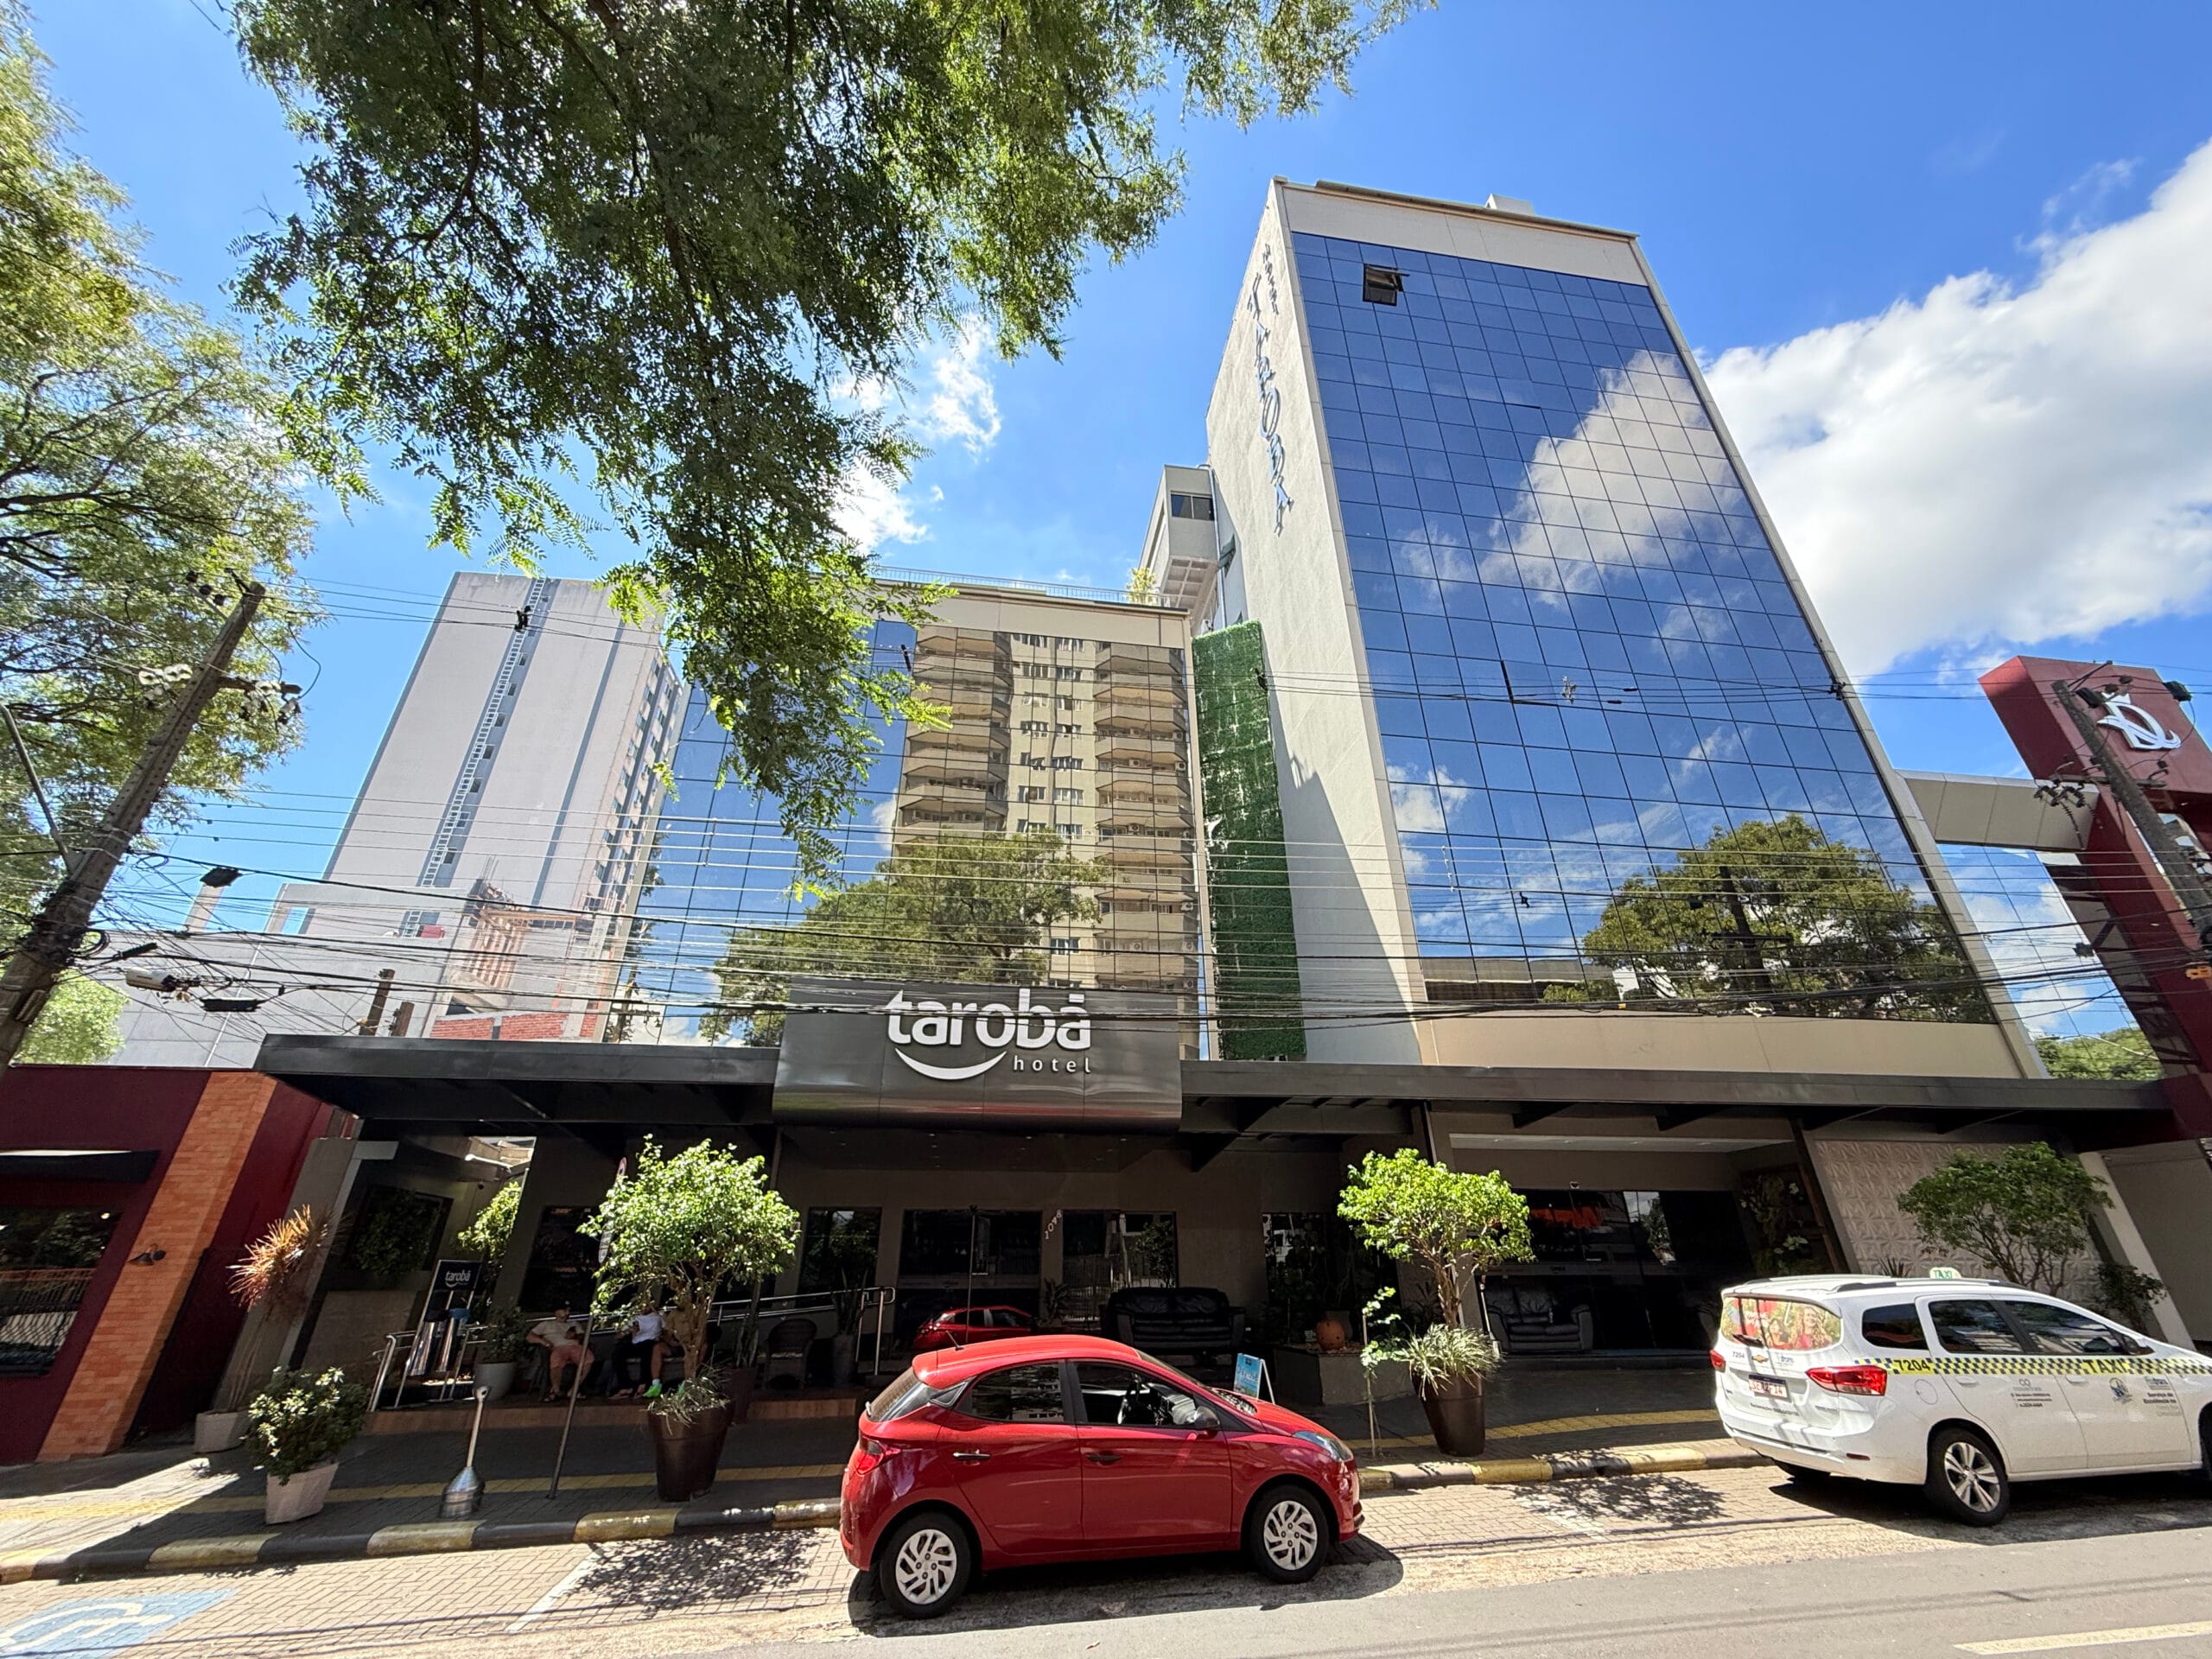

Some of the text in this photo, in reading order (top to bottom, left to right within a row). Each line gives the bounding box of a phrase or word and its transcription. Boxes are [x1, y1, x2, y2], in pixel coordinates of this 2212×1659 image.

[885, 988, 1091, 1050] tarobá
[1013, 1054, 1090, 1073] hotel
[1045, 1209, 1062, 1240] 1048
[445, 1269, 471, 1281] tarobá
[1933, 1269, 1953, 1280] TAXI
[1732, 1351, 1745, 1359] 7204
[1894, 1359, 1930, 1371] 7204
[2083, 1359, 2128, 1373] TAXI
